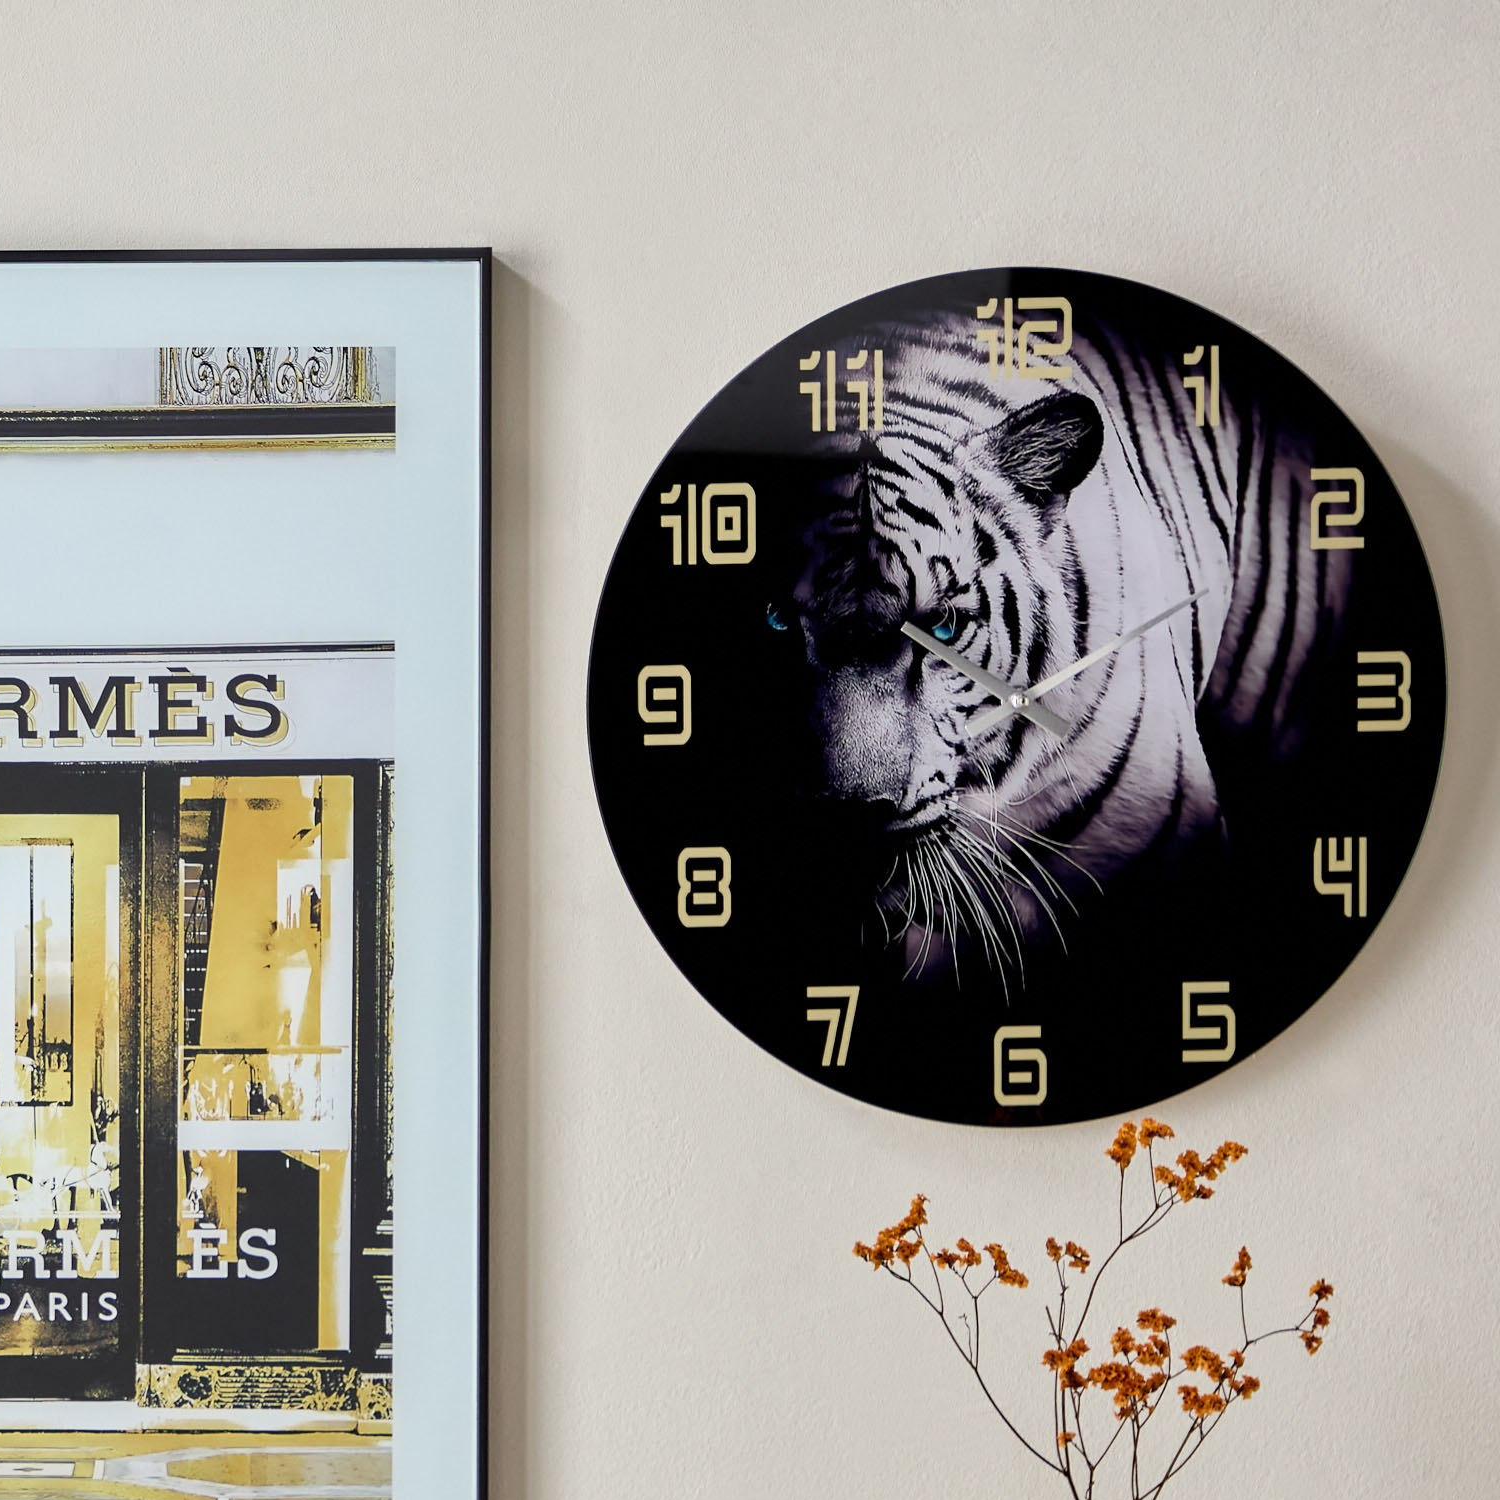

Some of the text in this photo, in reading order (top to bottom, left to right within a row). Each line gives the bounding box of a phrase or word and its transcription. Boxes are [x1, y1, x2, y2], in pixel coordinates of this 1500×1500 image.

[977, 297, 1072, 379] 12
[800, 350, 883, 431] 11
[1184, 345, 1220, 427] 1
[660, 483, 756, 565] 10
[1310, 468, 1365, 550] 2
[637, 664, 692, 747] 9
[1357, 650, 1412, 732] 3
[677, 846, 732, 928] 8
[1313, 836, 1368, 918] 4
[806, 985, 860, 1066] 7
[1182, 981, 1236, 1063] 5
[993, 1025, 1047, 1106] 6
